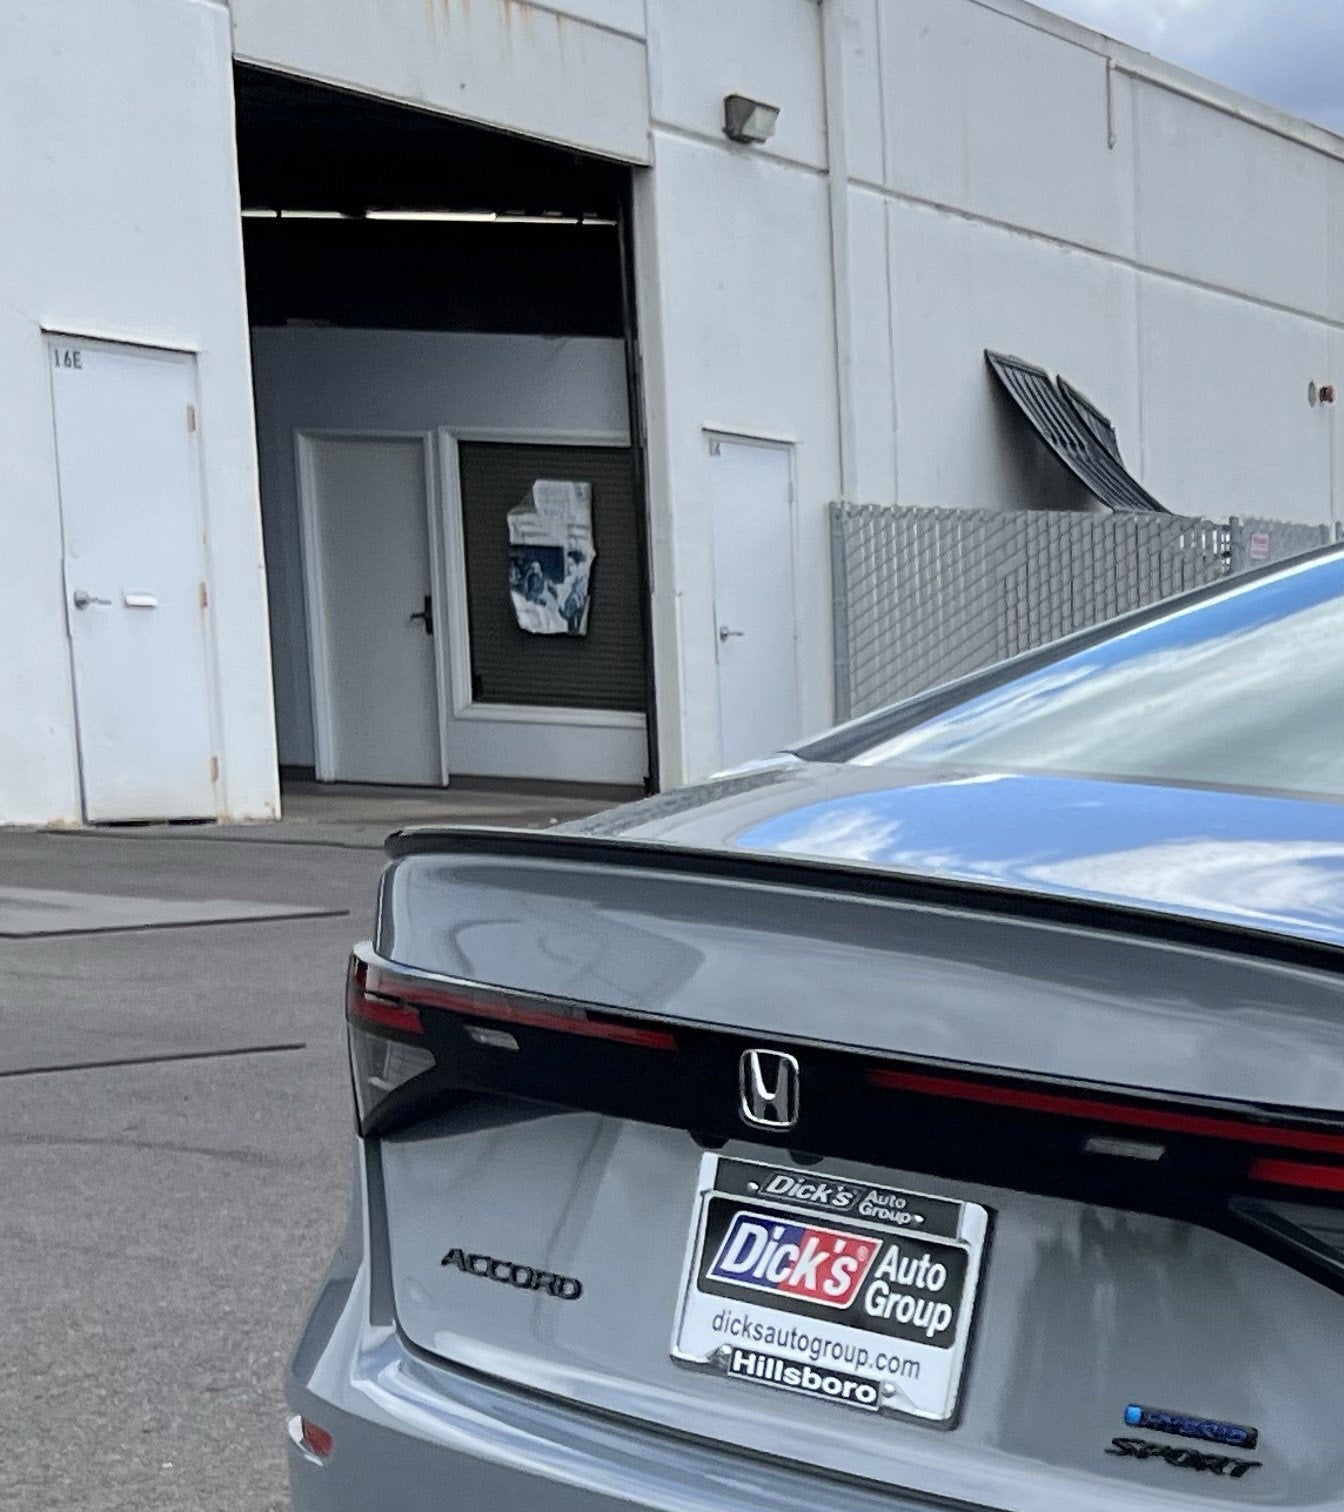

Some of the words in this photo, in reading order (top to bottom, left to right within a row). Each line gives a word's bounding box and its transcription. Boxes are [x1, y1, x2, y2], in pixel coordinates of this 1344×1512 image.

[766, 1174, 853, 1207] Dick's
[863, 1189, 907, 1209] Auto
[858, 1201, 912, 1225] Group
[440, 1248, 583, 1301] ACCORD
[720, 1221, 858, 1297] Dick's
[874, 1245, 947, 1292] Auto
[864, 1279, 953, 1337] Group
[711, 1309, 921, 1380] dicksautogroup.com
[732, 1350, 878, 1403] Hillsboro
